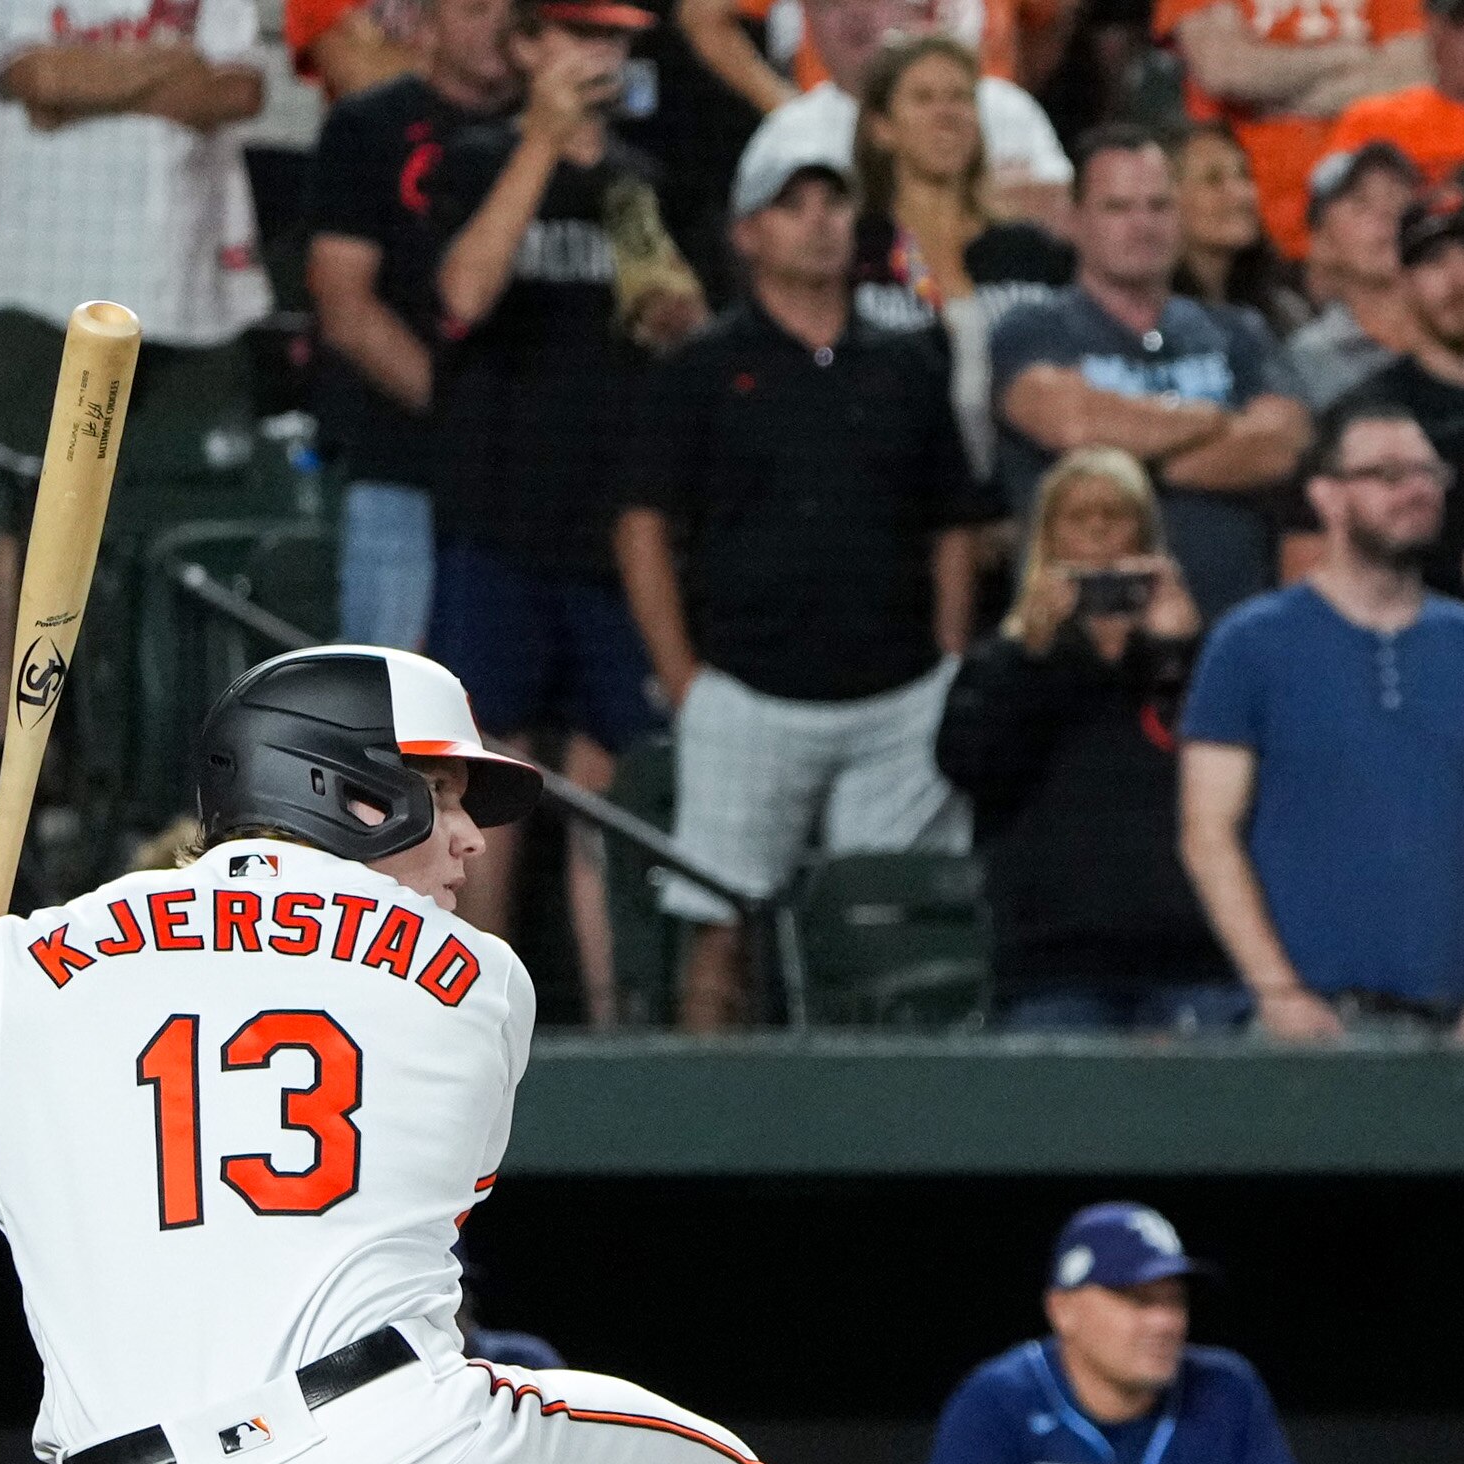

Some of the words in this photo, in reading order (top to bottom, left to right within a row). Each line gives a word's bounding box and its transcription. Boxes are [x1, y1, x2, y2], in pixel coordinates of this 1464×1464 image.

[97, 416, 113, 460] BALTIMORE
[27, 888, 481, 1007] KJERSTAD
[136, 1009, 363, 1232] 13
